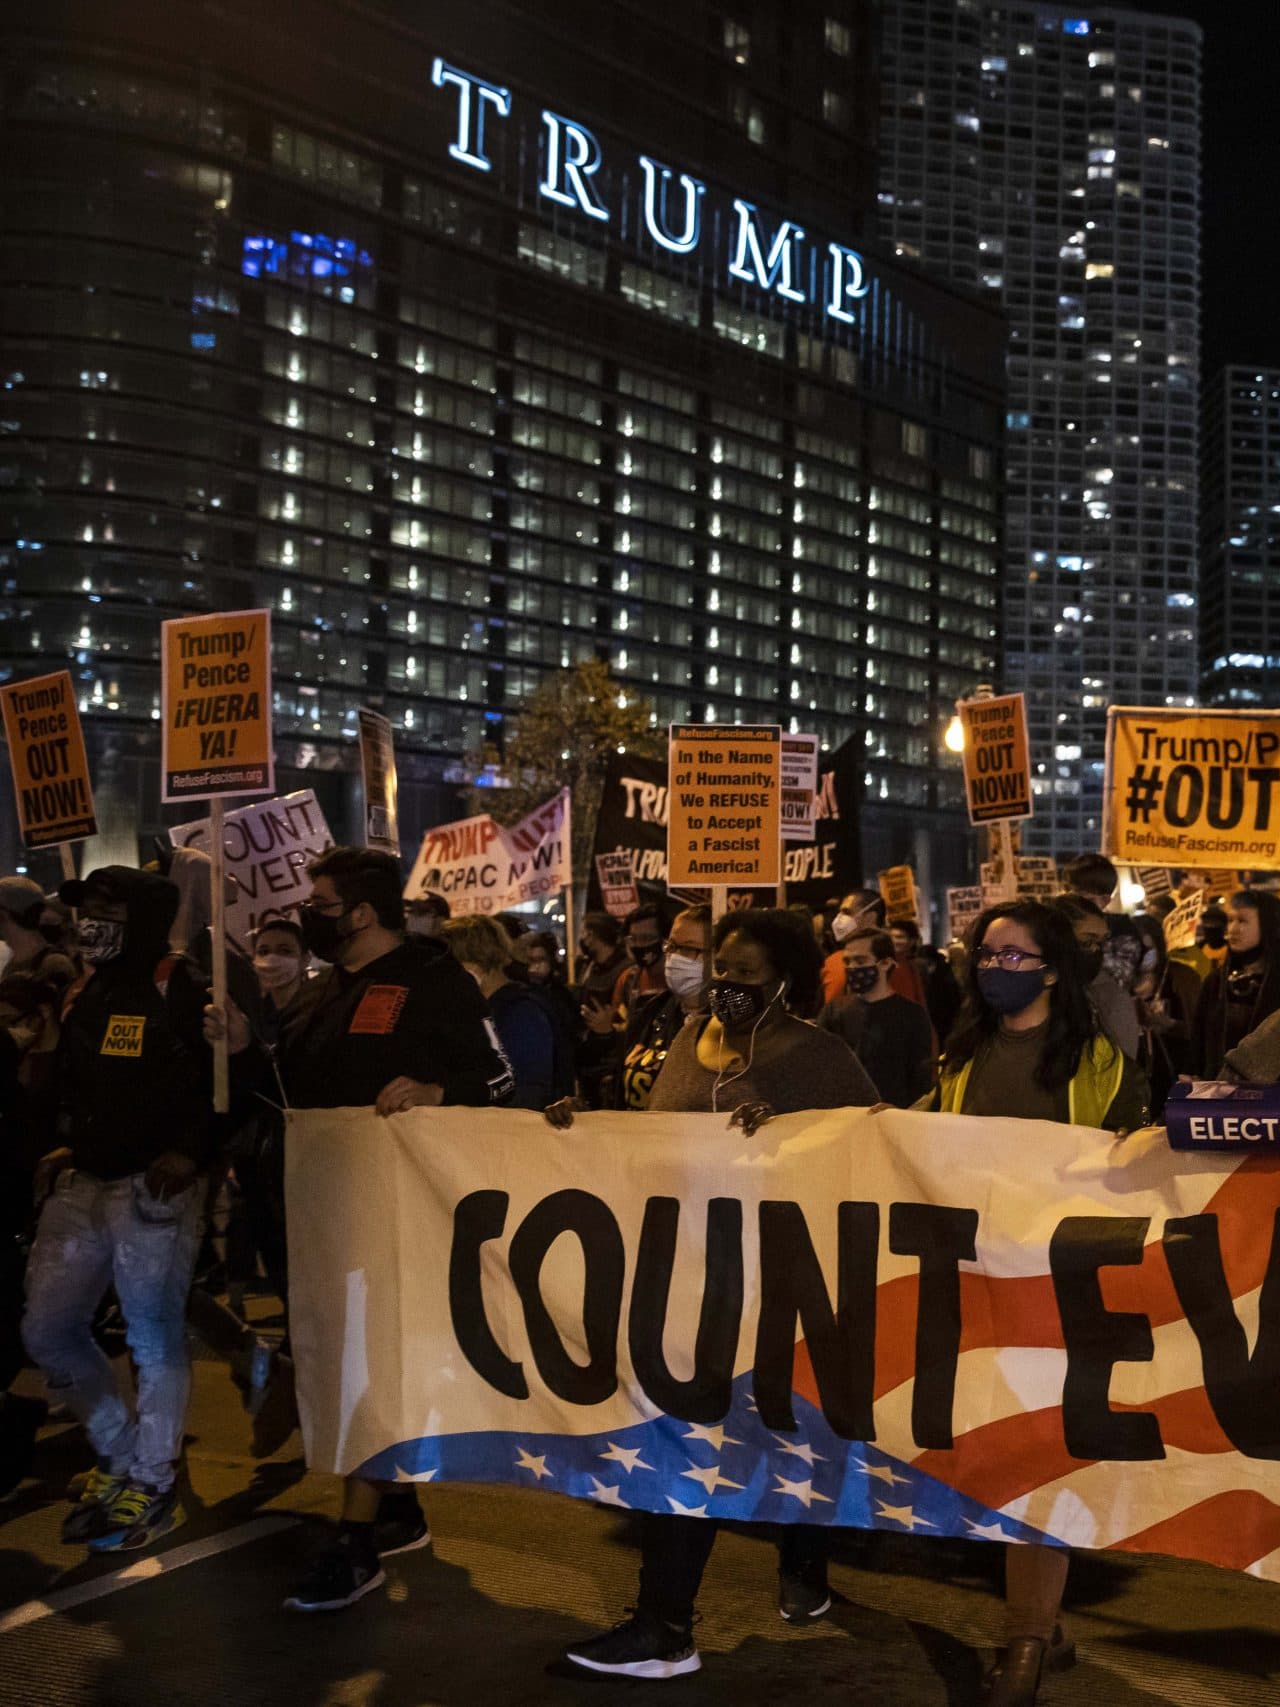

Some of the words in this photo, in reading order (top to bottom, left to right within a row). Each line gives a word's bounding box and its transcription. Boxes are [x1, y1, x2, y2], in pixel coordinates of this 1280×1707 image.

[431, 57, 869, 323] TRUMP
[178, 624, 256, 658] Trump/
[183, 662, 249, 690] Pence
[9, 679, 65, 714] Trump/
[174, 692, 260, 729] ¡FUERA
[18, 712, 68, 741] Pence
[967, 700, 1016, 725] Trump/
[199, 729, 237, 761] YA!
[679, 728, 773, 741] RefuseFascism.org
[972, 724, 1015, 744] Pence
[26, 737, 70, 781] OUT
[678, 751, 693, 764] In
[698, 750, 723, 764] the
[728, 750, 773, 764] Name
[976, 742, 1015, 773] OUT
[172, 769, 263, 788] RefuseFascism.org
[675, 771, 691, 785] of
[697, 772, 775, 788] Humanity,
[971, 772, 1025, 805] NOW!
[22, 777, 89, 825] NOW!
[680, 794, 704, 807] We
[709, 793, 769, 807] REFUSE
[687, 816, 703, 829] to
[707, 816, 762, 832] Accept
[424, 820, 498, 865] TRUMP
[688, 840, 698, 851] a
[704, 837, 761, 851] Fascist
[1126, 830, 1276, 857] RefuseFascism.org
[228, 839, 331, 899] VERY
[442, 864, 498, 892] CPAC
[507, 840, 563, 887] NW!
[688, 859, 759, 874] America!
[784, 843, 837, 883] EOPLE
[105, 1036, 141, 1051] NOW
[111, 1023, 139, 1038] OUT
[449, 1188, 979, 1450] COUNT
